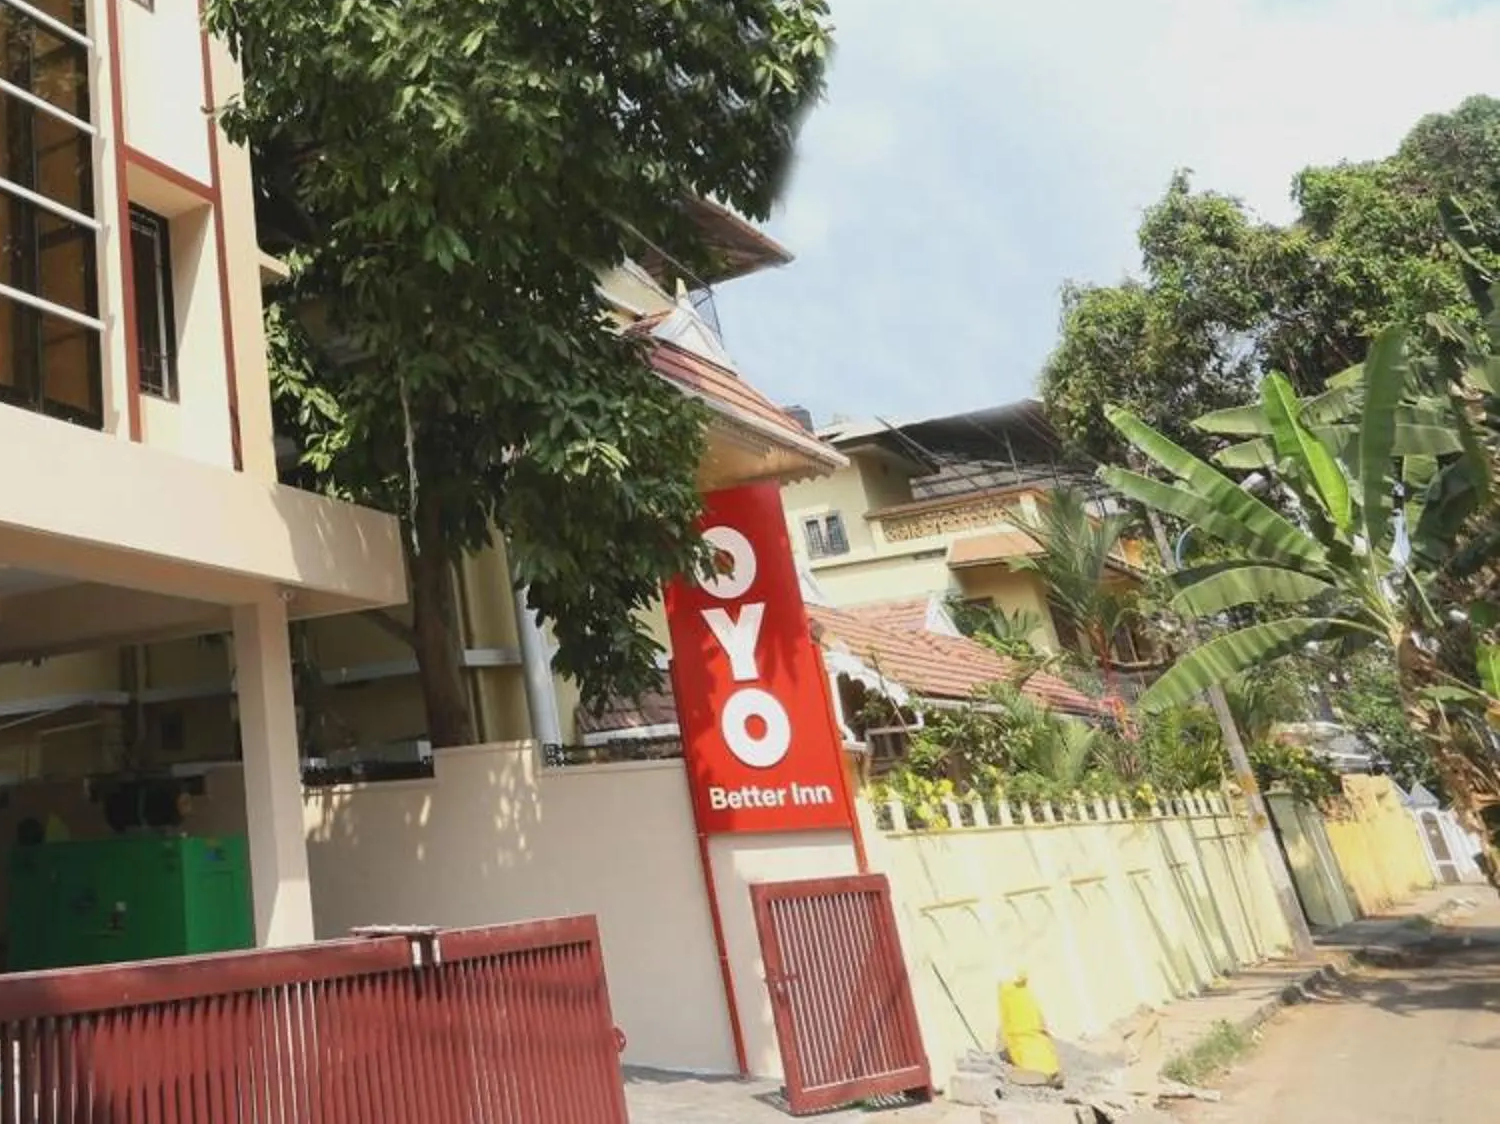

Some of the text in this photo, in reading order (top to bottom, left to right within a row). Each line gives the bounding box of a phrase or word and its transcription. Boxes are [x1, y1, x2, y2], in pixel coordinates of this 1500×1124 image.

[693, 525, 791, 768] OYO
[709, 782, 833, 810] Better Inn
